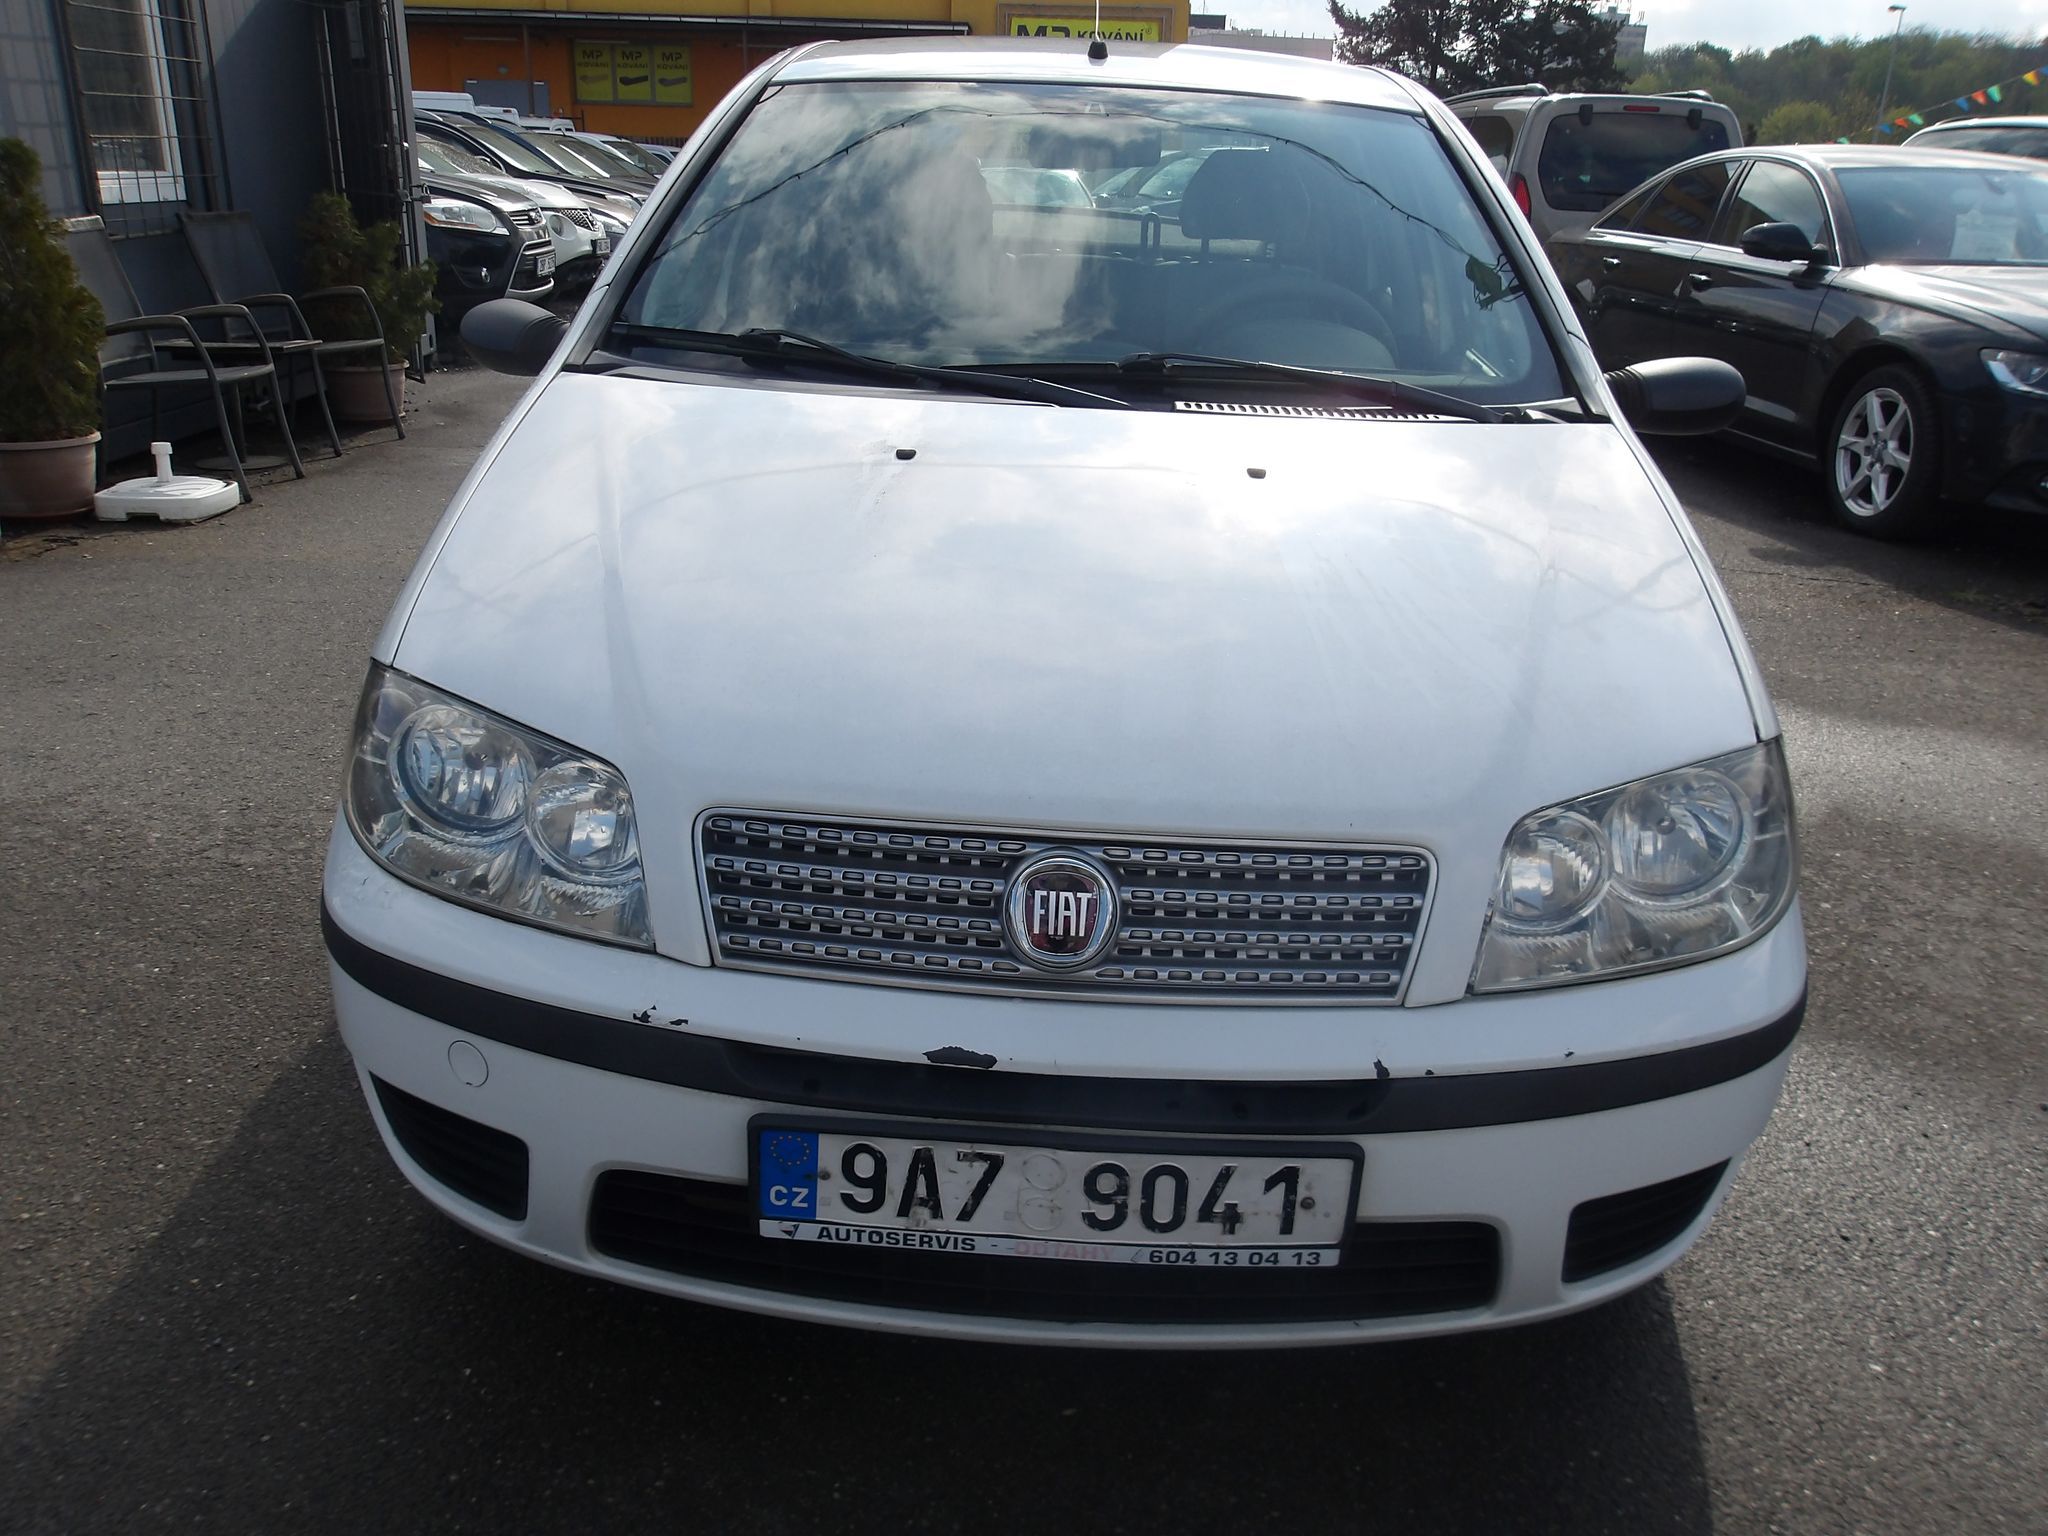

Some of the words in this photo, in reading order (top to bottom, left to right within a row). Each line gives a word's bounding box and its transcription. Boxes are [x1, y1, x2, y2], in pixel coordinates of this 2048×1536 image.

[1033, 889, 1093, 937] FIAT
[769, 1185, 809, 1208] CZ
[839, 1141, 1005, 1222] 9A7
[1081, 1161, 1301, 1236] 9041
[816, 1225, 976, 1252] AUTOSERVIS
[1149, 1249, 1197, 1265] 604
[1208, 1250, 1238, 1266] 13
[1248, 1251, 1279, 1266] 04
[1291, 1251, 1321, 1266] 13
